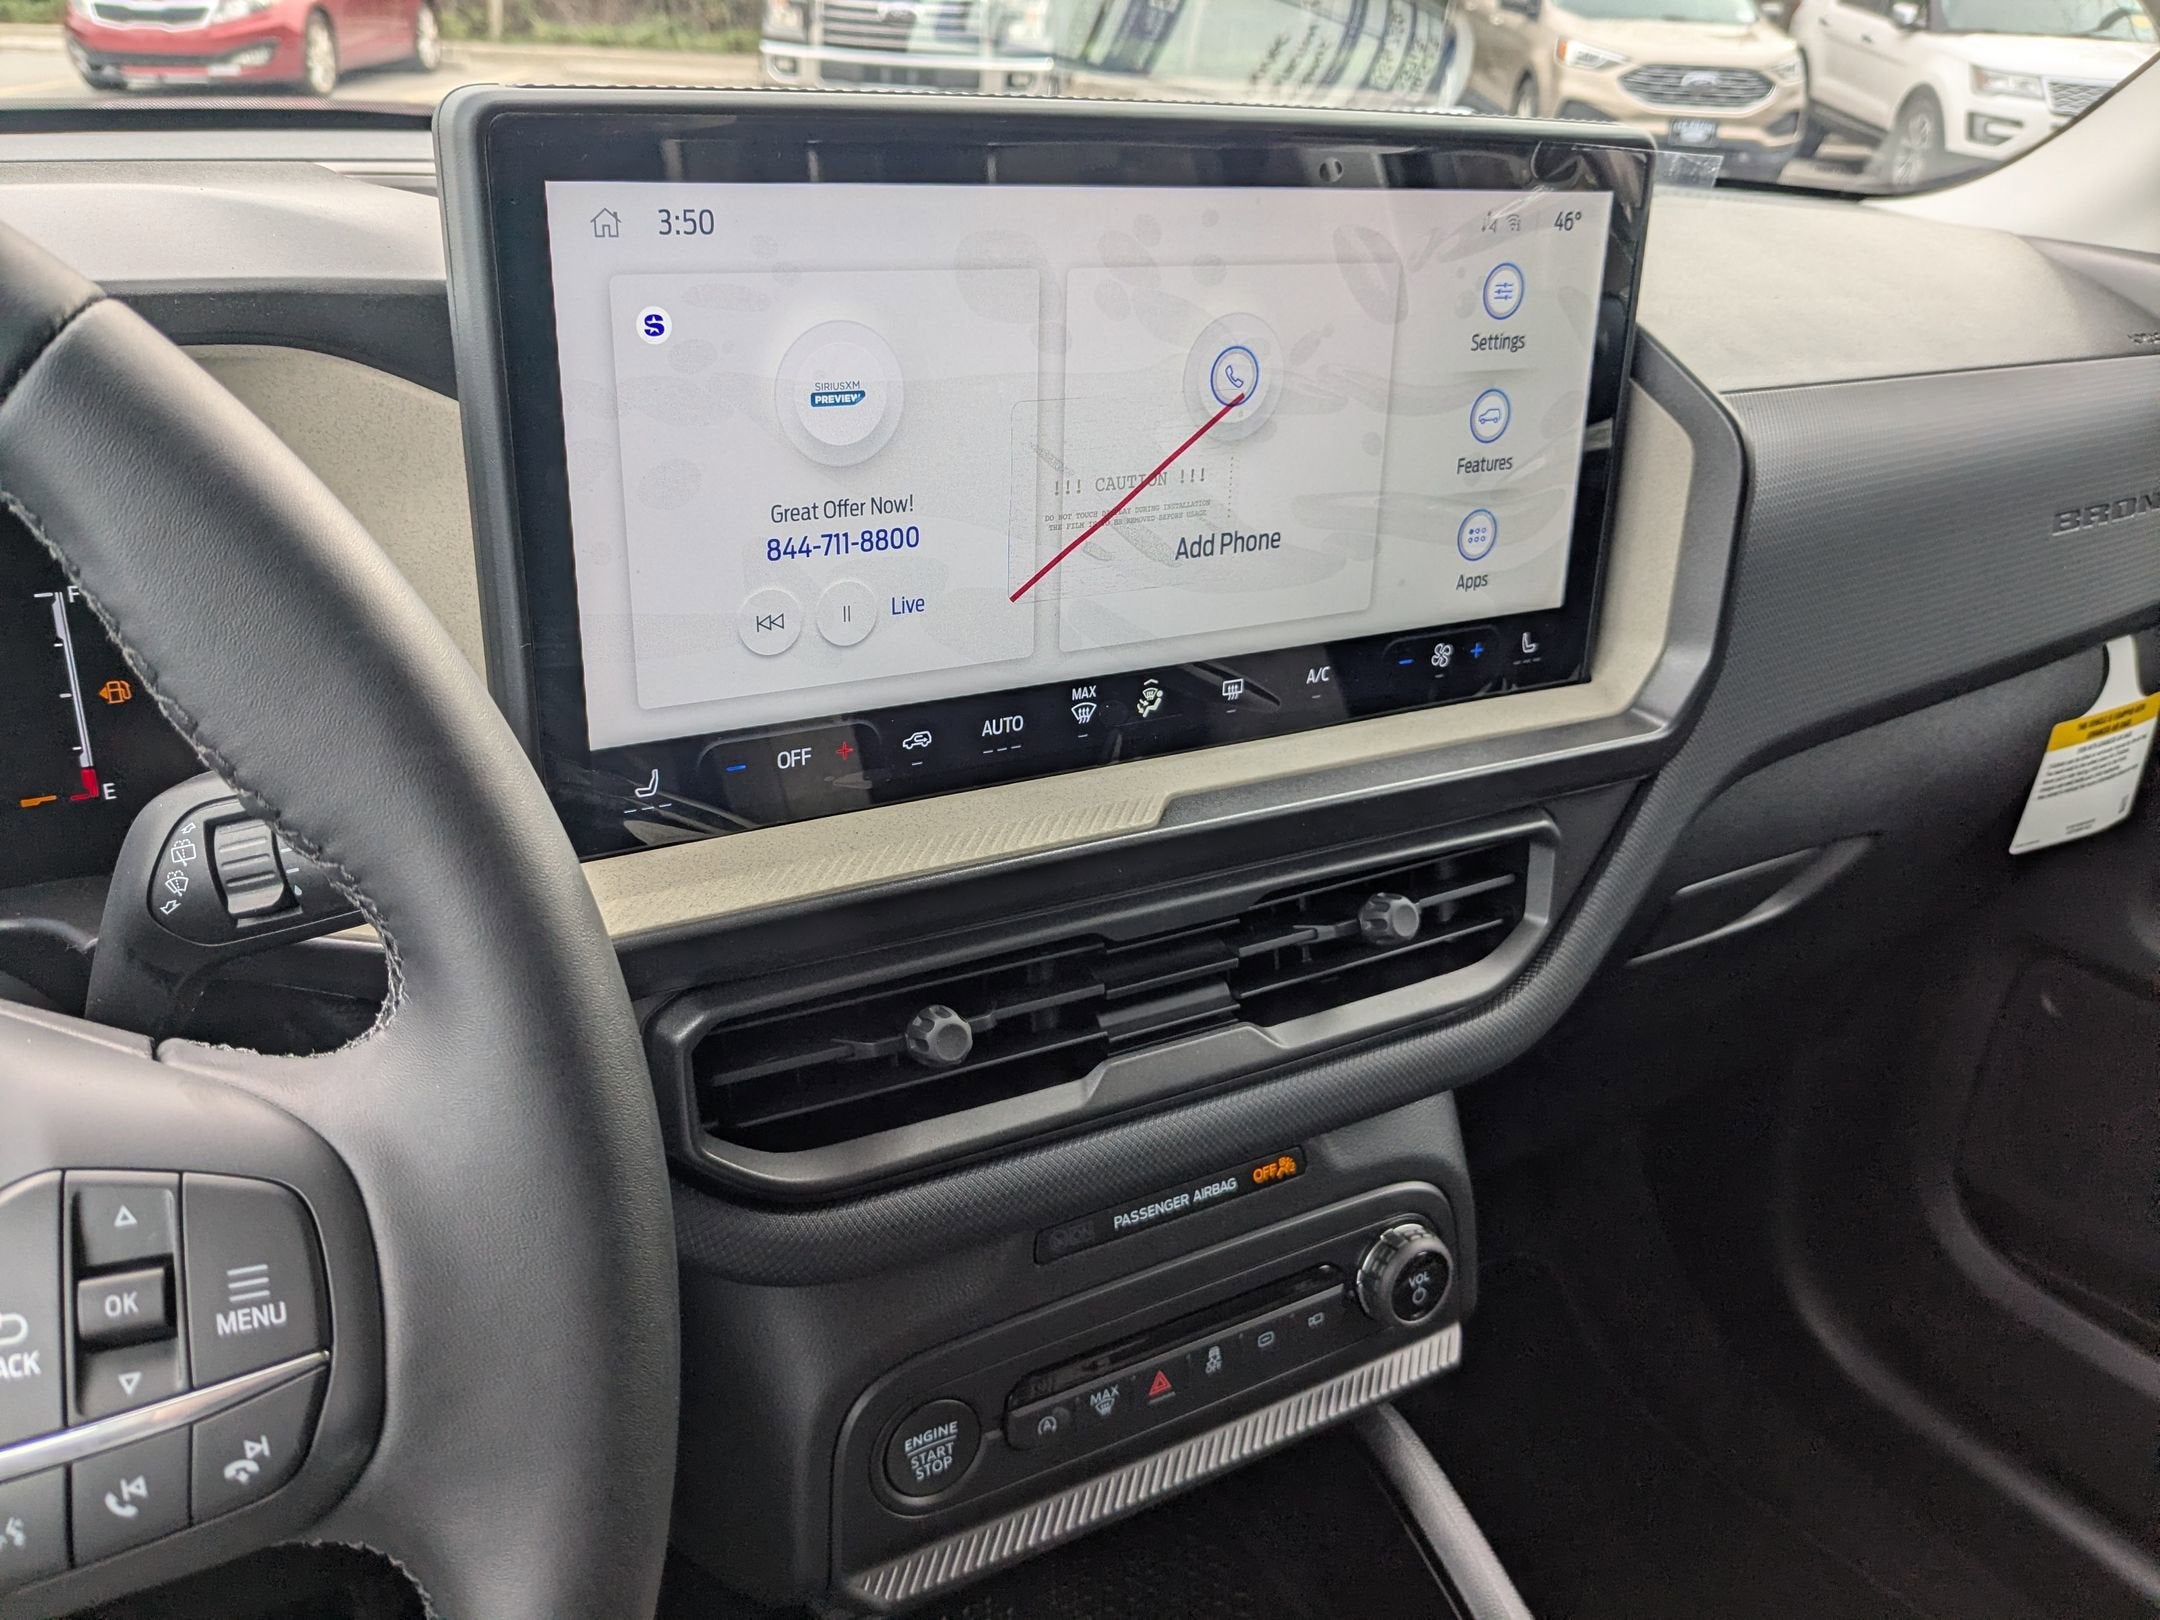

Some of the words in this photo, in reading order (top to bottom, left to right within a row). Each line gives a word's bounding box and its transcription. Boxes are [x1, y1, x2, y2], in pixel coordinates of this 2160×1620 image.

[657, 208, 715, 237] 3:50
[1470, 331, 1526, 353] Settings
[814, 380, 861, 392] SIRIUSXM
[813, 392, 862, 405] PREVIEW
[1456, 454, 1513, 475] Features
[771, 502, 819, 523] Great
[823, 497, 866, 519] Offer
[871, 494, 914, 515] Now!
[766, 525, 920, 561] 844-711-8800
[1174, 534, 1215, 561] Add
[1219, 530, 1281, 555] Phone
[1456, 572, 1488, 592] Apps
[67, 585, 80, 602] F
[890, 593, 925, 616] Live
[1306, 665, 1331, 686] A/C
[1071, 685, 1097, 701] MAX
[981, 715, 1024, 737] AUTO
[777, 747, 812, 769] OFF
[103, 782, 117, 800] E
[1253, 1163, 1277, 1184] OFF
[1113, 1193, 1190, 1230] PASSENGER
[1193, 1177, 1238, 1203] AIRBAG
[1408, 1271, 1430, 1288] VOL
[104, 1291, 138, 1318] OK
[215, 1301, 288, 1337] MENU
[1089, 1384, 1120, 1405] MAX
[904, 1420, 958, 1452] ENGINE
[910, 1441, 954, 1470] START
[915, 1455, 953, 1482] STOP
